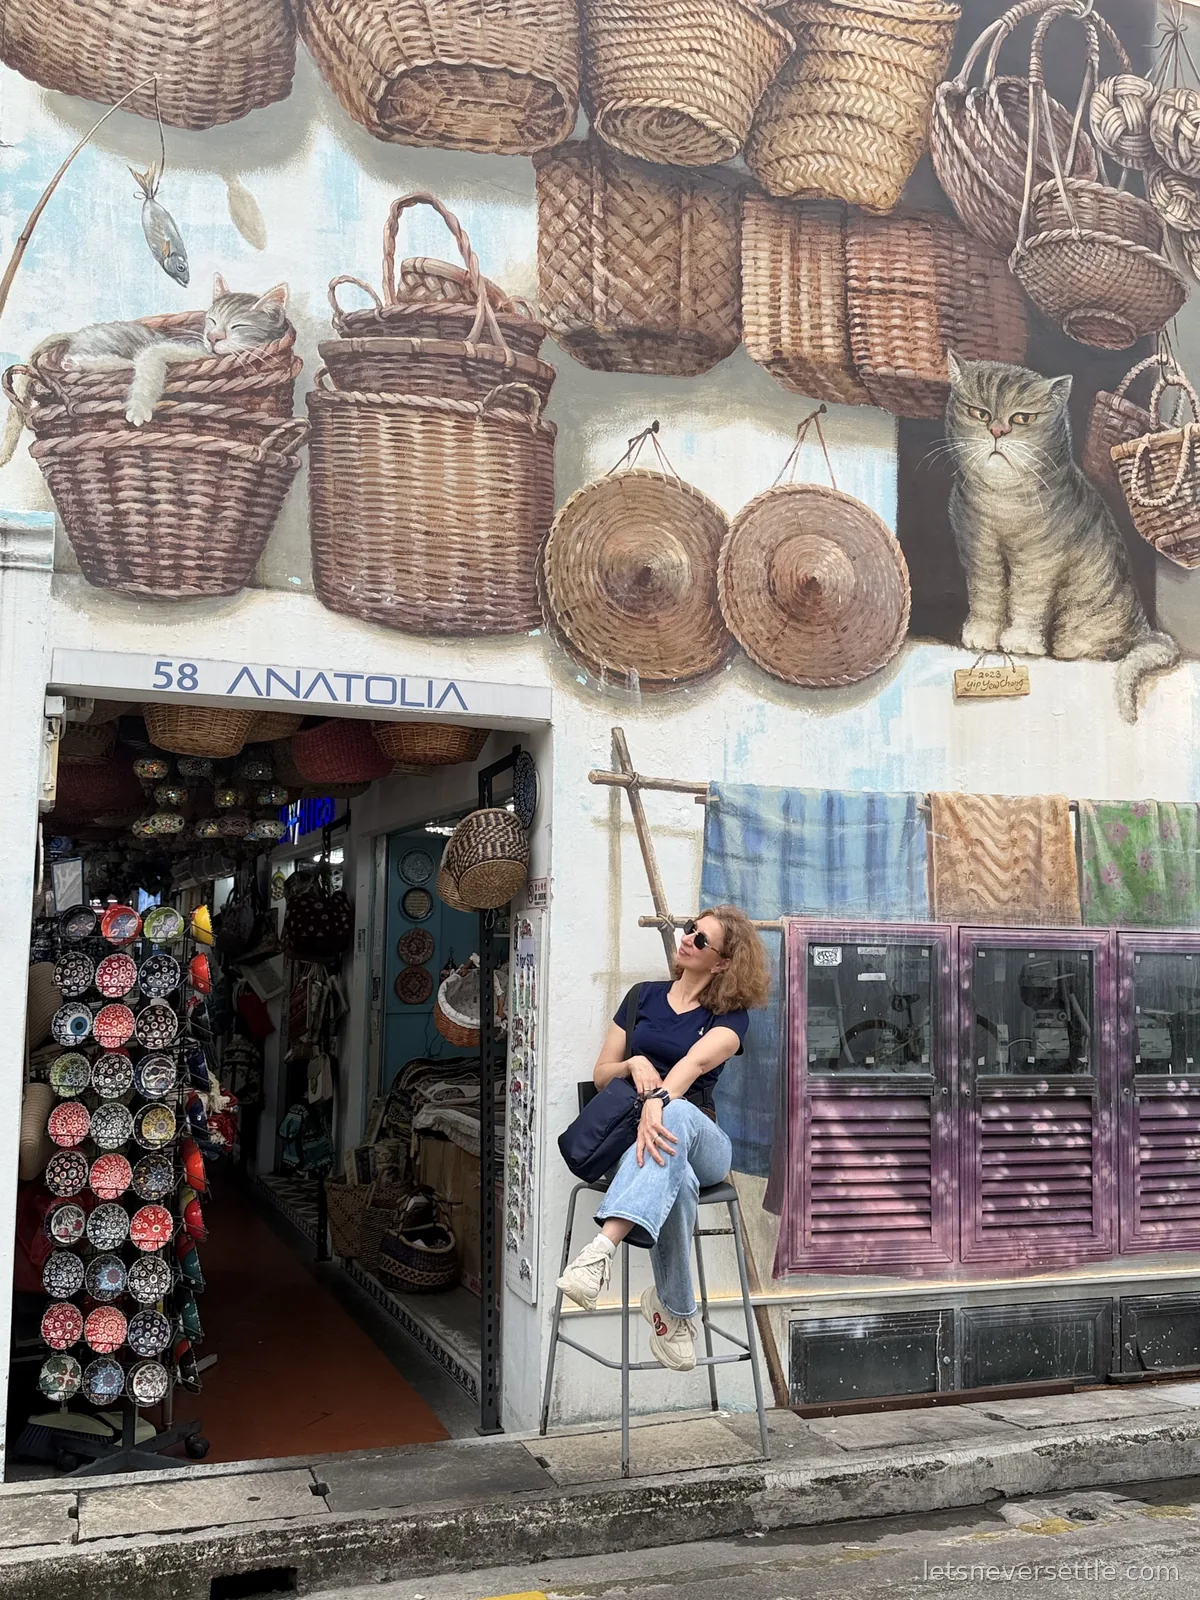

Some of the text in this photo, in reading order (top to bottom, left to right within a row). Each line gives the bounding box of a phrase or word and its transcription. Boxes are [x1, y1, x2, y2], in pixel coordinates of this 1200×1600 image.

[152, 660, 469, 711] 58 ANATOLIA
[978, 670, 1002, 679] 2023
